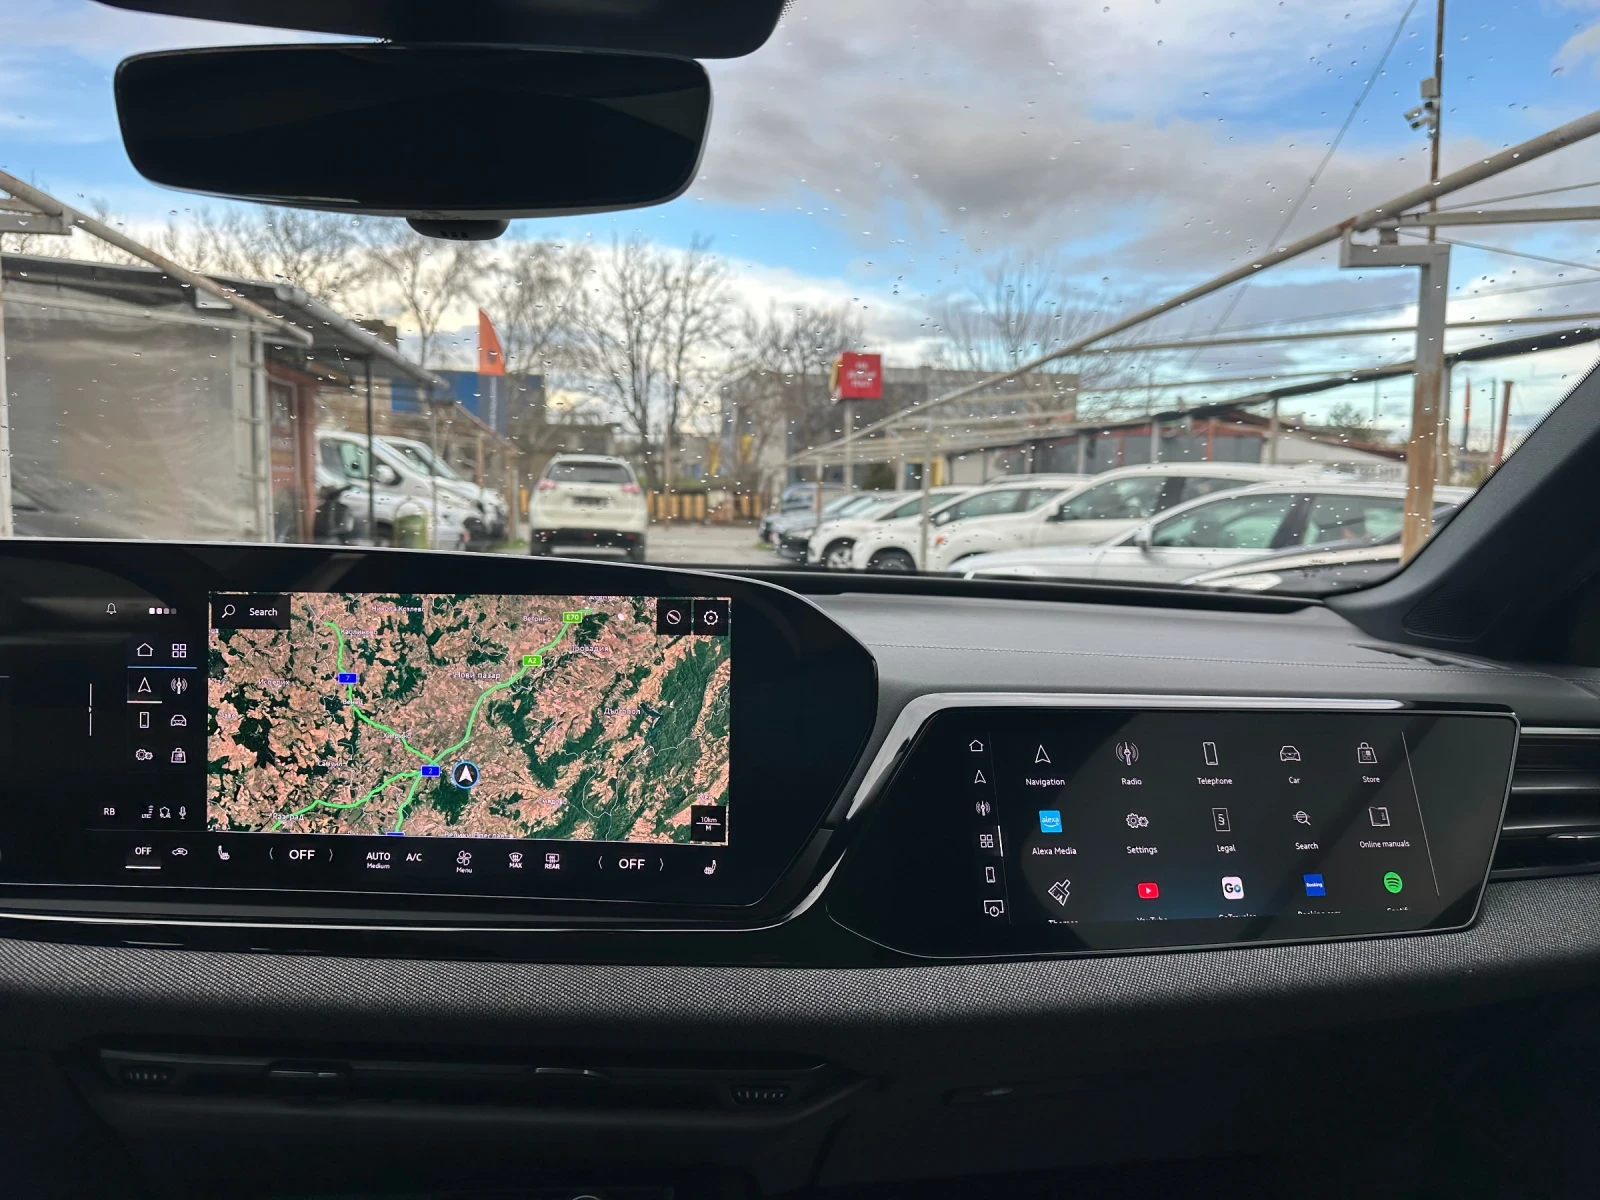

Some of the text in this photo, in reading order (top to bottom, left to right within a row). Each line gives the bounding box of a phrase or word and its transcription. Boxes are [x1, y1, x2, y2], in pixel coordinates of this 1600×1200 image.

[249, 607, 278, 616] Search
[527, 657, 537, 665] A2
[1025, 778, 1066, 788] Navigation
[1121, 777, 1143, 786] Radio
[1196, 777, 1233, 787] Telephone
[1288, 776, 1300, 784] Car
[1362, 775, 1381, 783] Store
[103, 807, 116, 816] RB
[1216, 844, 1237, 854] Legal
[1295, 842, 1319, 850] Search
[1359, 840, 1411, 849] Online manuals
[134, 847, 152, 856] OFF
[288, 849, 316, 860] OFF
[1032, 847, 1077, 855] Alexa Media
[1126, 845, 1159, 856] Settings
[366, 851, 391, 861] AUTO
[405, 853, 423, 862] A/C
[366, 862, 390, 870] Medium
[618, 858, 646, 870] OFF
